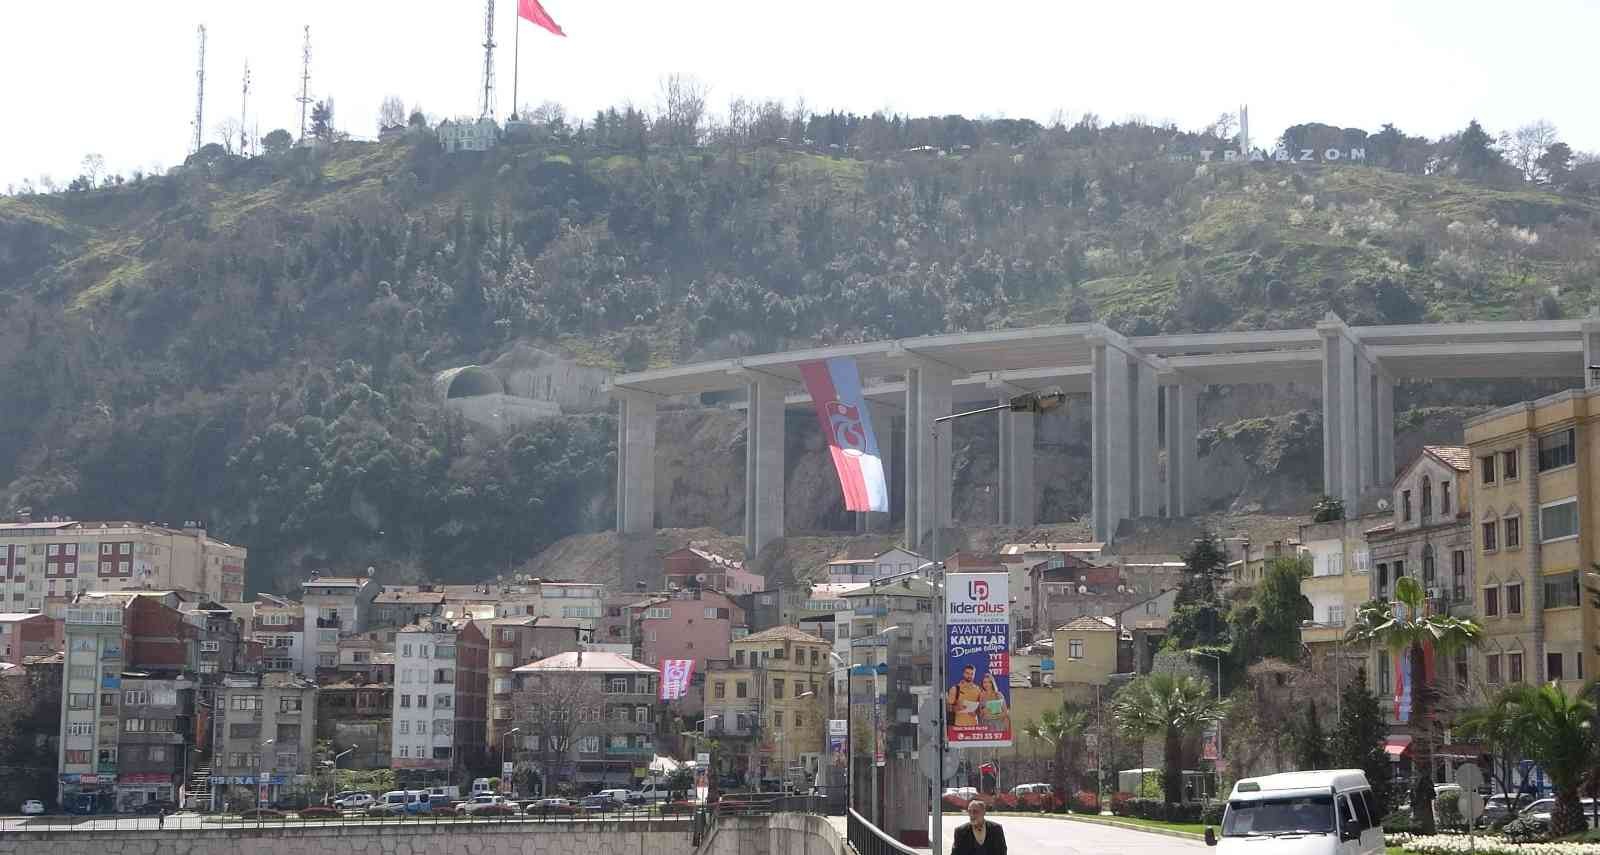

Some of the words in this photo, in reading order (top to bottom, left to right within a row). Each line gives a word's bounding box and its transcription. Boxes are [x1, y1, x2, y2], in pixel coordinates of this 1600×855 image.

[1200, 149, 1366, 162] TRABZON
[950, 602, 1005, 615] liderplus
[951, 625, 1006, 635] AVANTAJLI
[950, 635, 1006, 645] KAYITLAR
